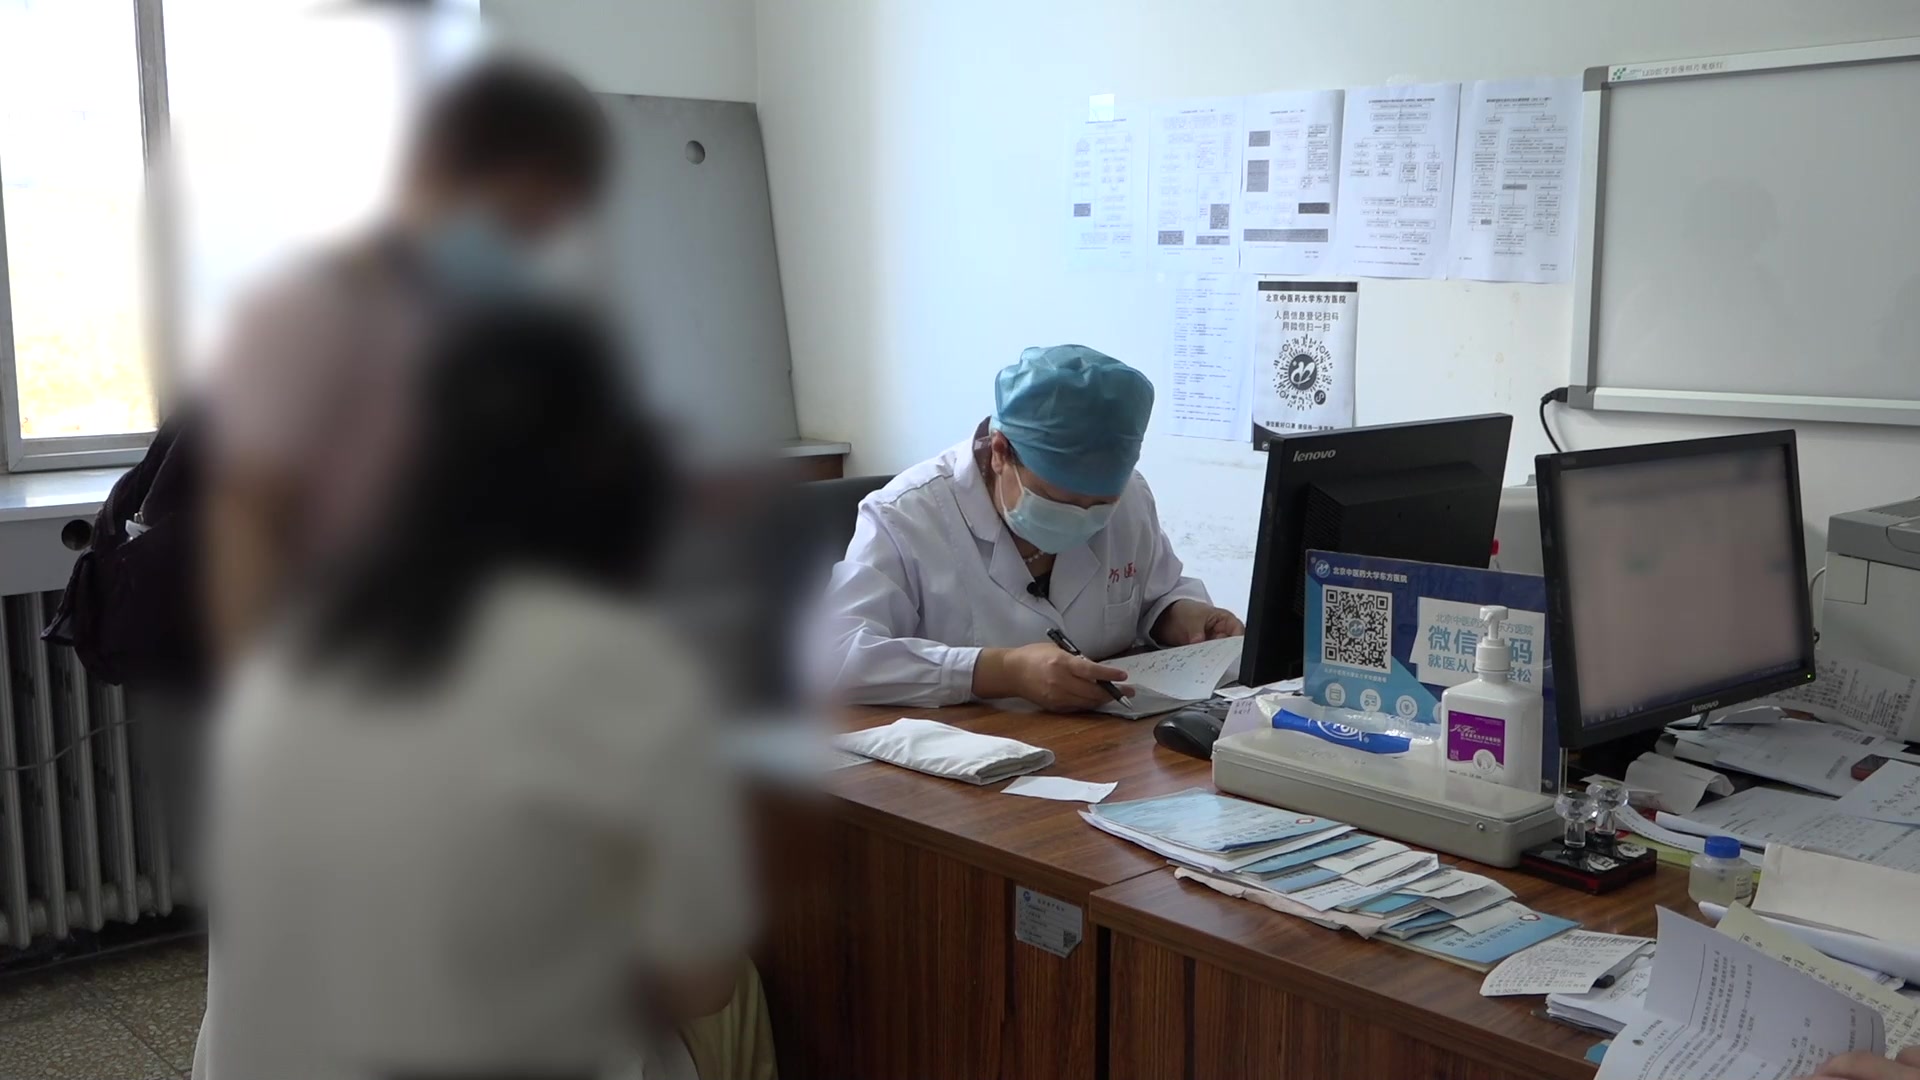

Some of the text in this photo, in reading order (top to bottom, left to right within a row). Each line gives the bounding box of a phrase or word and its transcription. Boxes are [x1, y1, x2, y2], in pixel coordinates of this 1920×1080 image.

[1266, 294, 1346, 303] 北京中医药大学东方医院
[1274, 310, 1339, 321] 人员信息登记扫码
[1282, 321, 1331, 332] 用微信扫一扫
[1293, 449, 1336, 462] lenovo
[1333, 566, 1408, 584] 北京中医药大学东方医院
[1428, 624, 1533, 665] 微信码
